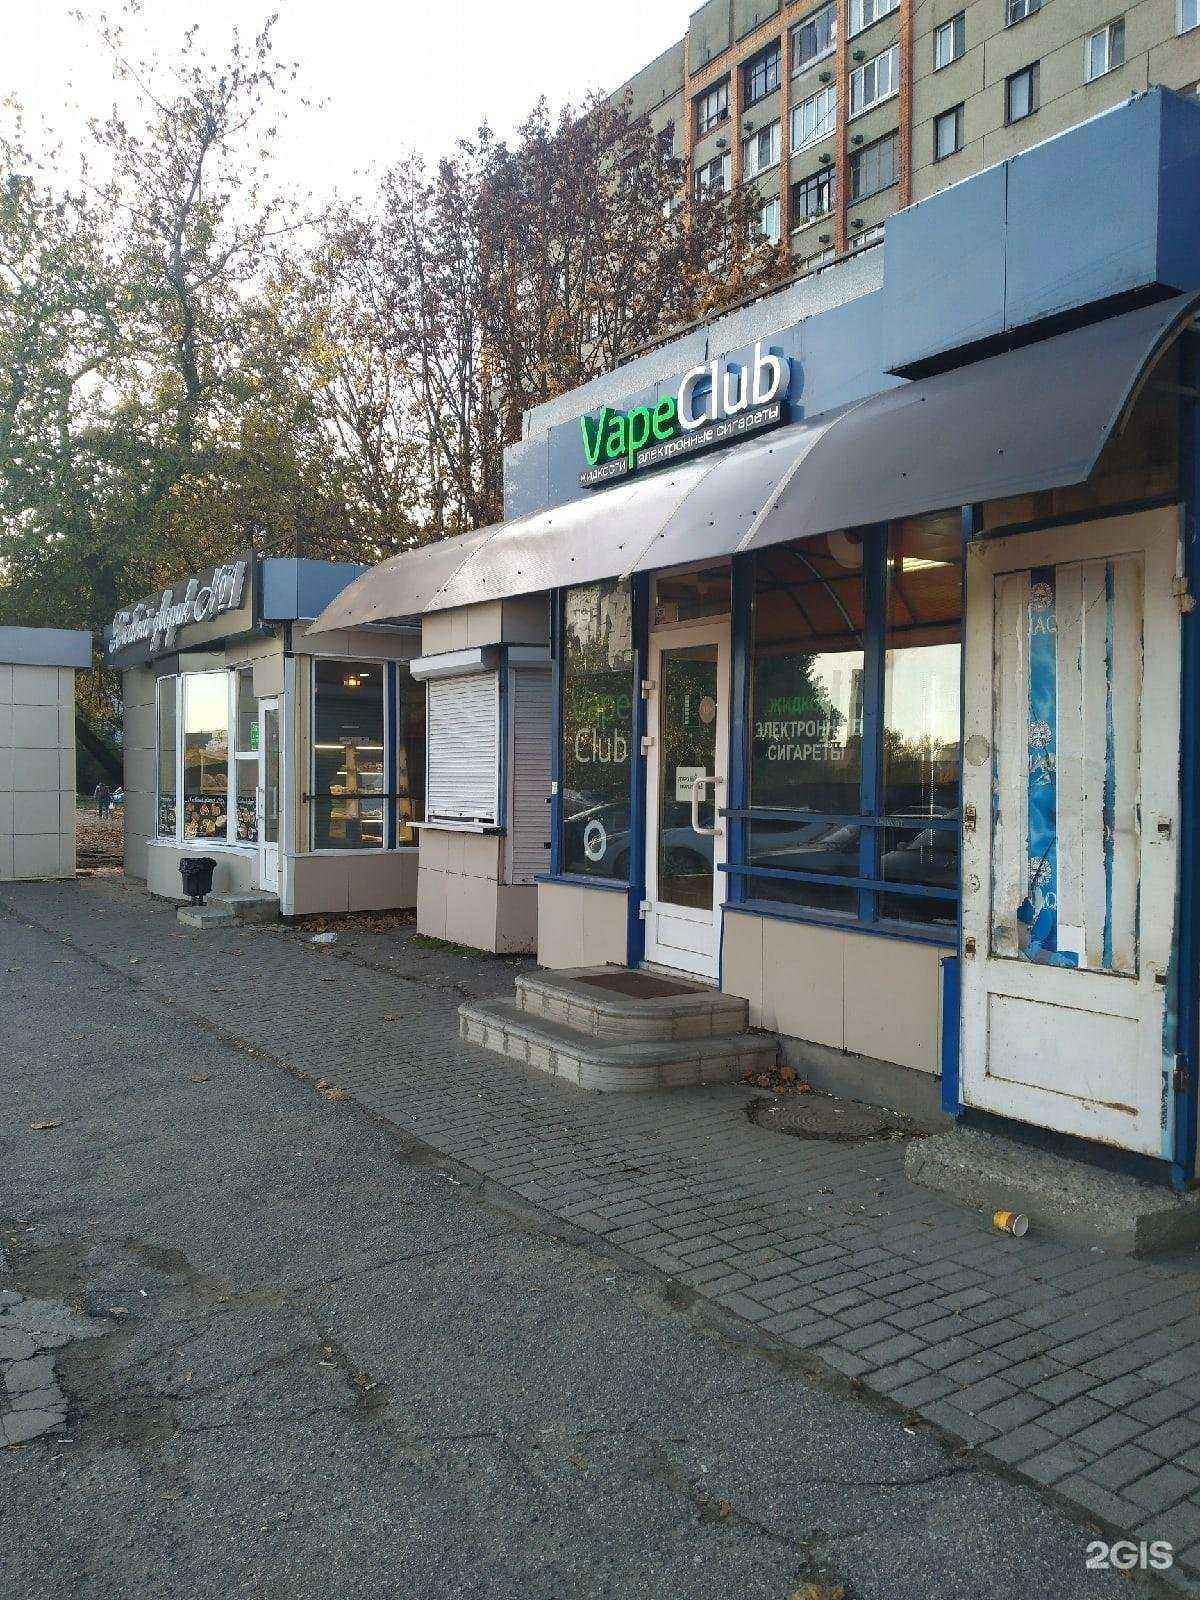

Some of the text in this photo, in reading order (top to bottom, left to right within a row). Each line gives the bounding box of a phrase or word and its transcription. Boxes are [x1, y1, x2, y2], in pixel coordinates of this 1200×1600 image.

[638, 429, 714, 465] электронные
[716, 405, 780, 438] сигареты
[575, 727, 628, 764] Club
[767, 743, 845, 761] СИГАРЕТЫ
